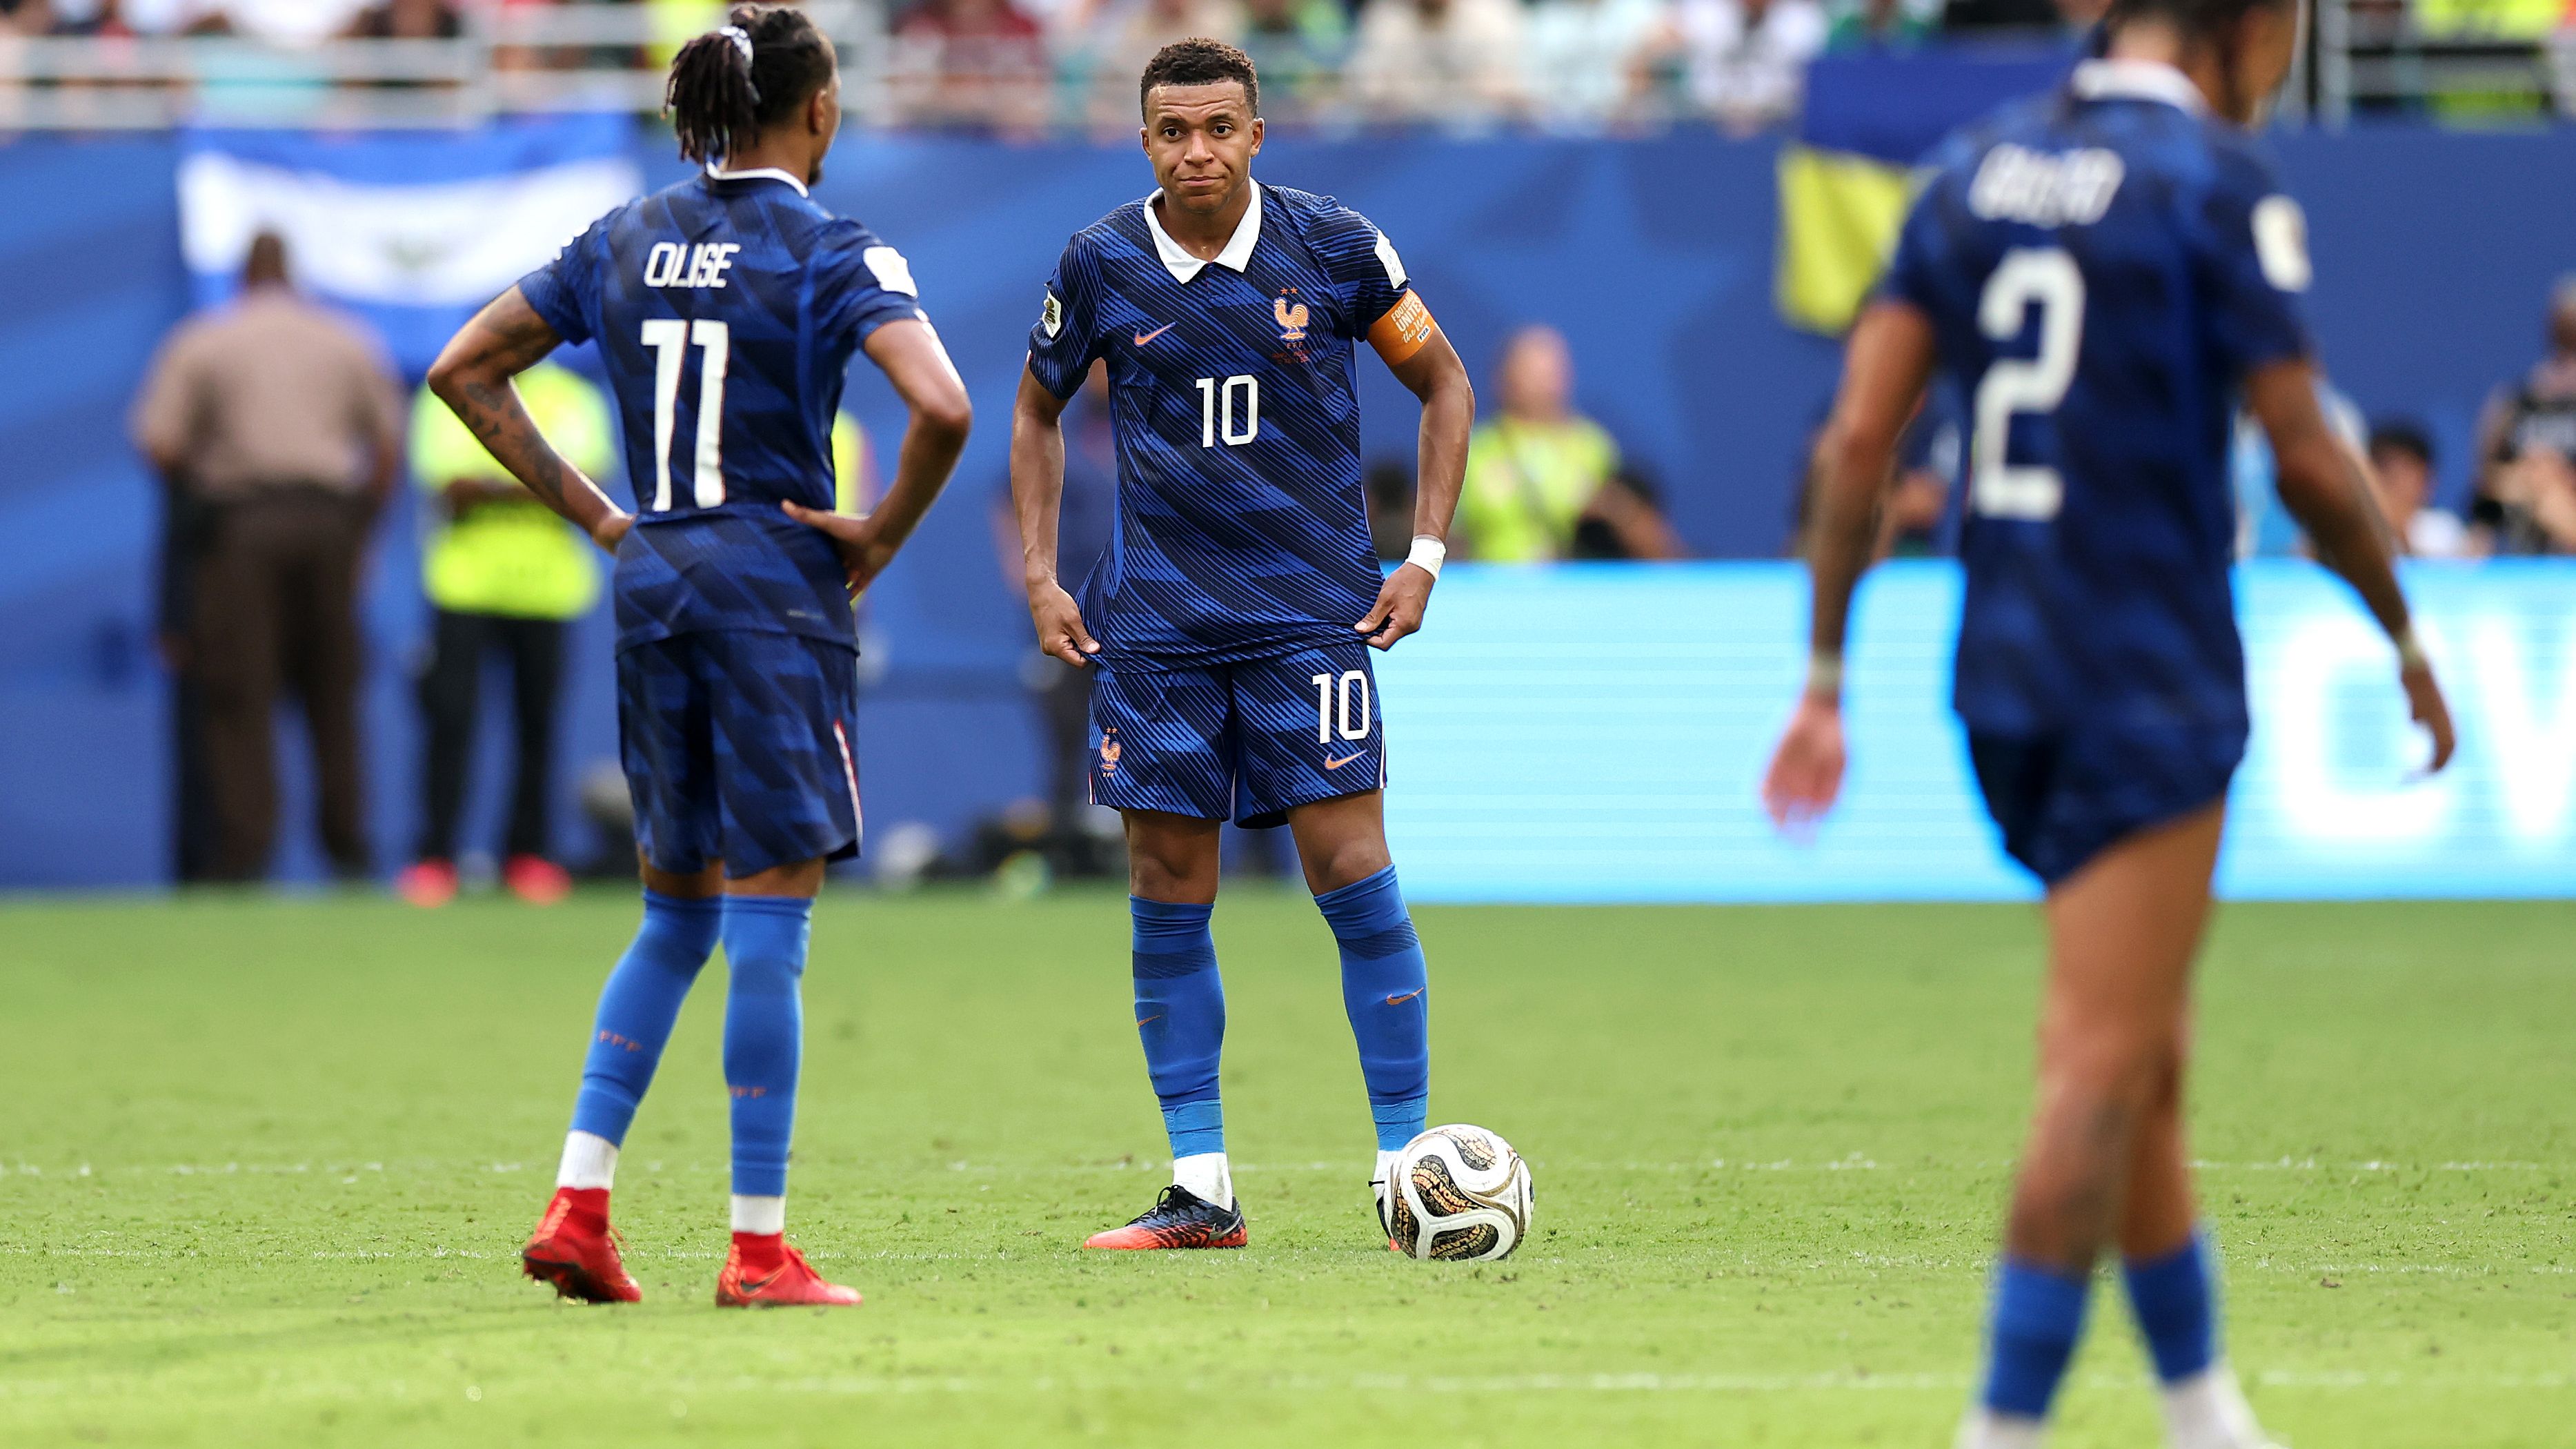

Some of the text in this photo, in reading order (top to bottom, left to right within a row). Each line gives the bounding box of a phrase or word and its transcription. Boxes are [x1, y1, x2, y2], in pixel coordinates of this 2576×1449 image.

[643, 241, 741, 288] OLISE
[1391, 291, 1415, 322] FOOTBALL
[1395, 297, 1423, 332] UNITES
[1418, 327, 1429, 341] FIFA
[1973, 246, 2086, 522] 2
[641, 318, 730, 513] 11
[1195, 373, 1259, 448] 10
[1312, 669, 1371, 744] 10
[1416, 1168, 1469, 1206] NEW YORK
